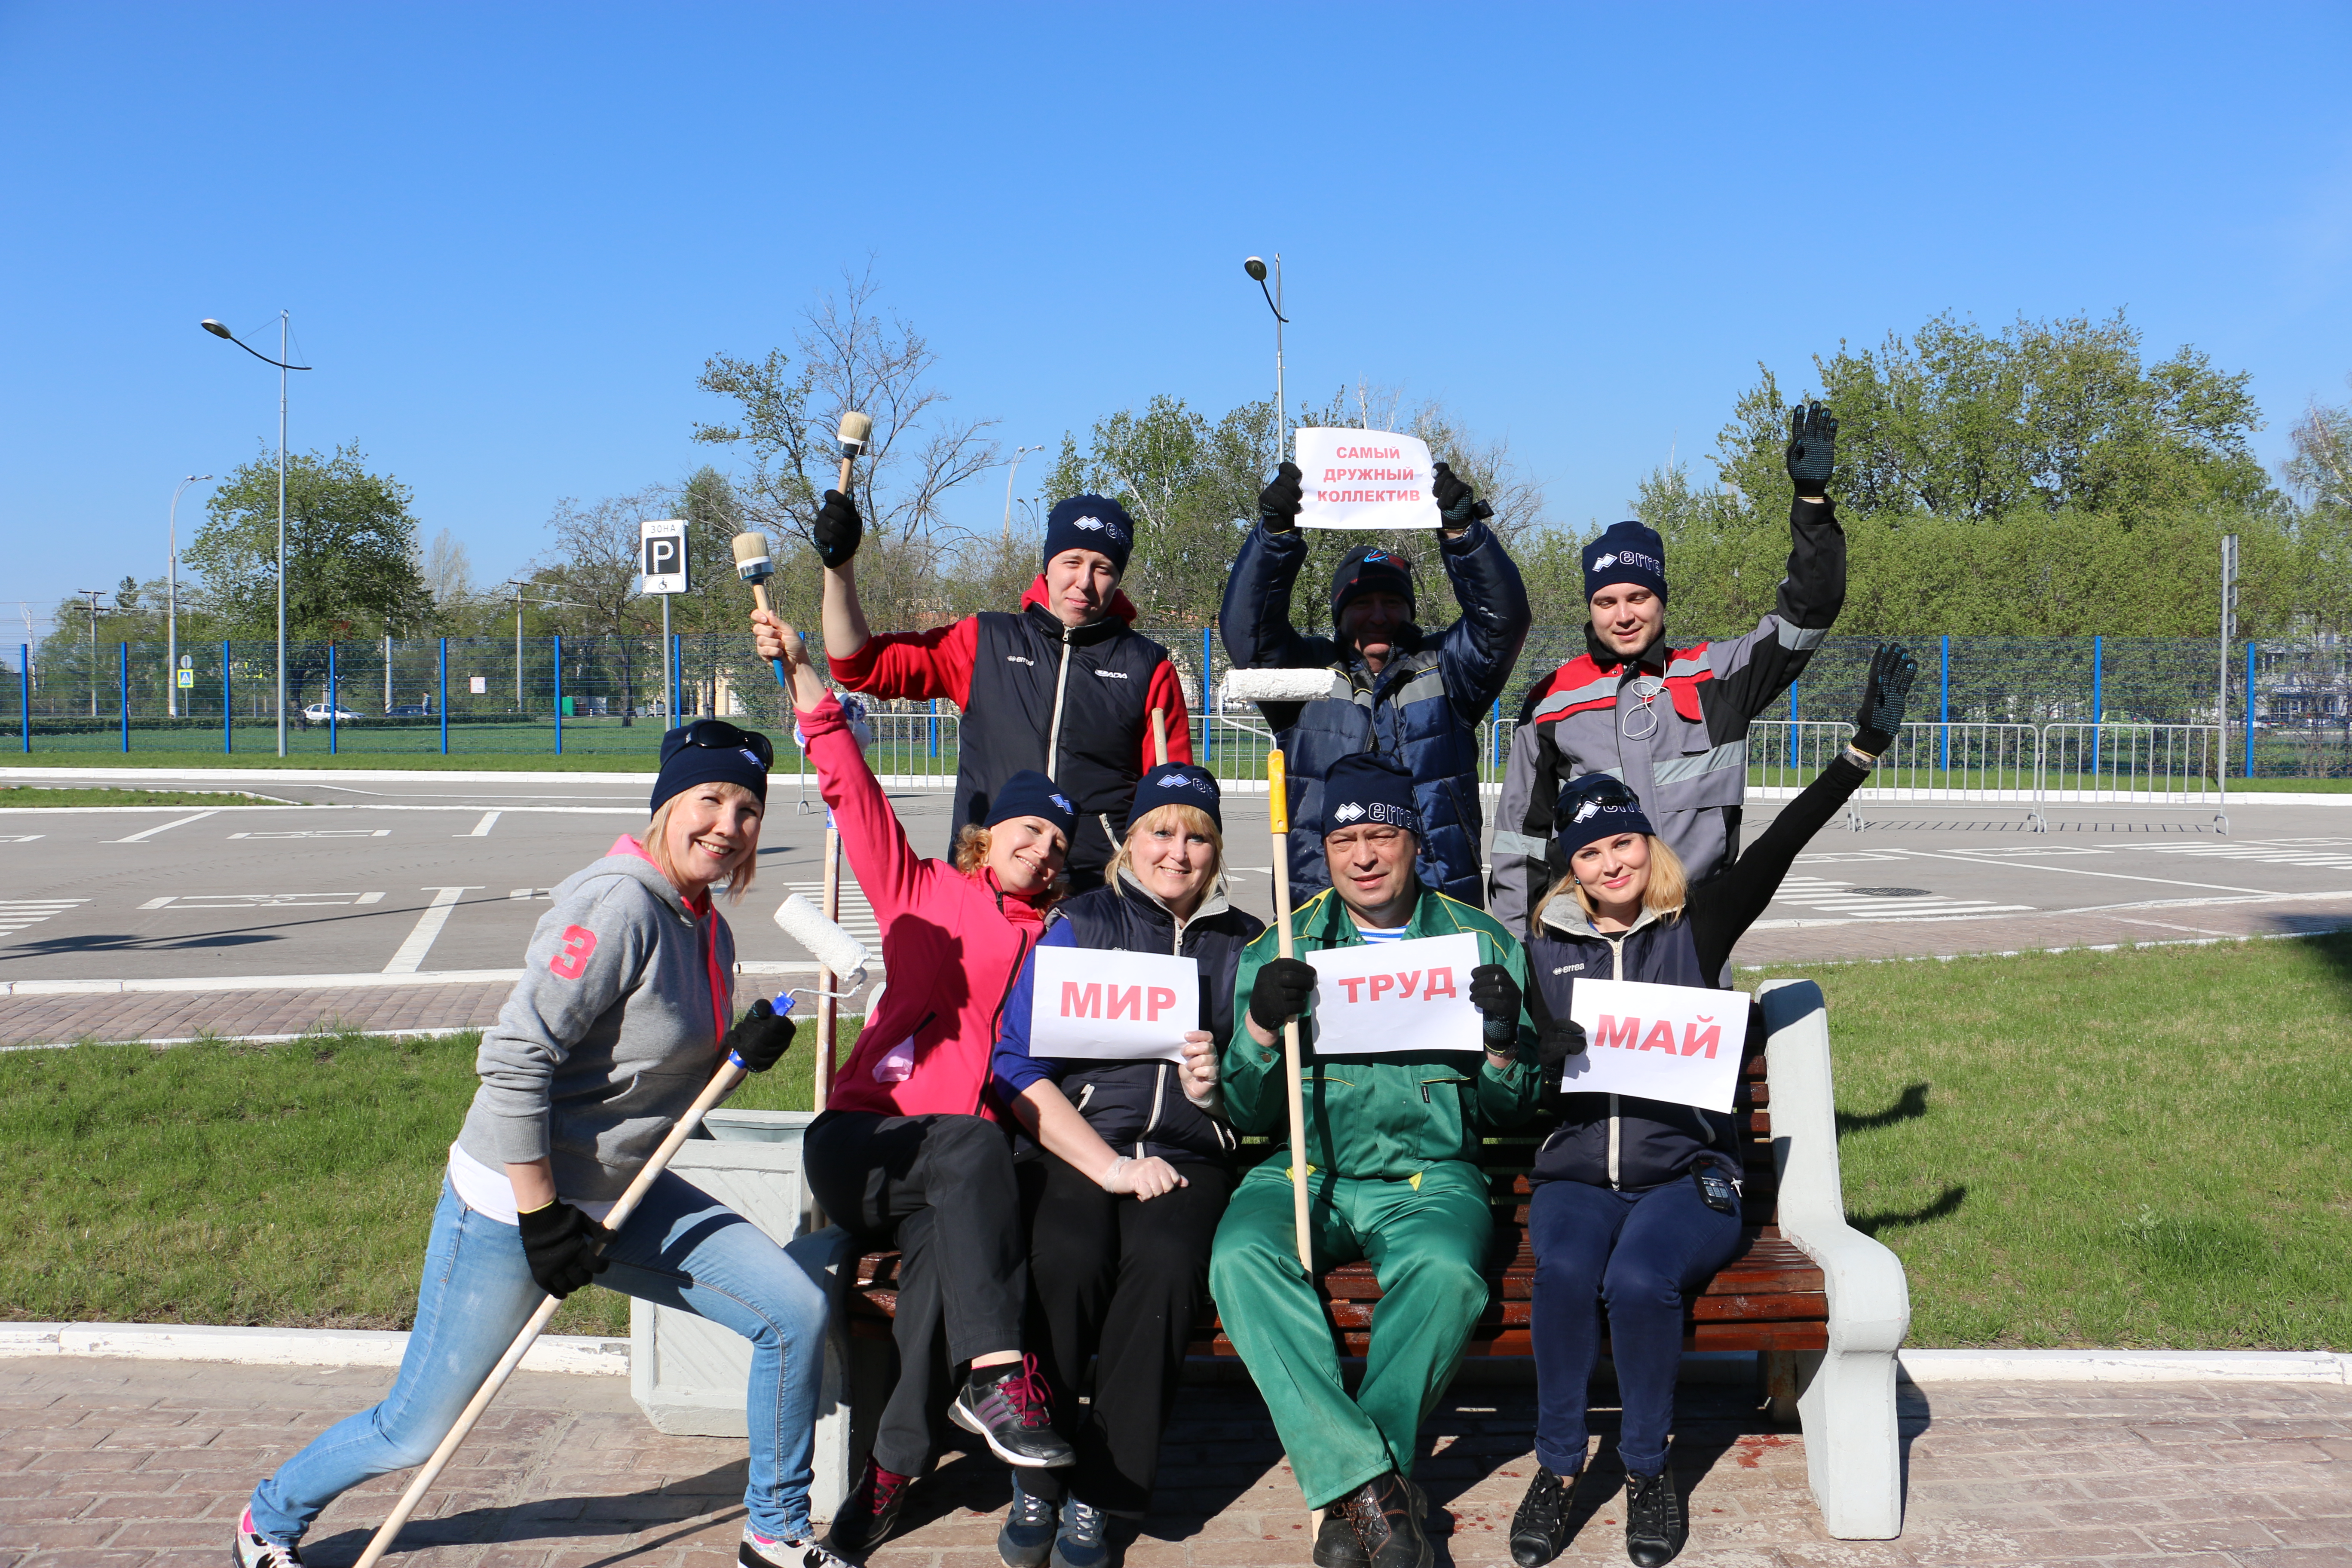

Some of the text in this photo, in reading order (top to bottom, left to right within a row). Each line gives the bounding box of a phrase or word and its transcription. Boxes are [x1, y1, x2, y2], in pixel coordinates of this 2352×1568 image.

[1336, 446, 1400, 459] САМЫЙ
[1323, 466, 1414, 483] ДРУЖНЫЙ
[1317, 490, 1420, 502] КОЛЛЕКТИВ
[650, 524, 676, 533] ЗОНА
[653, 541, 674, 573] P
[549, 924, 598, 980] 3
[1563, 962, 1585, 973] errea
[1338, 967, 1456, 1003] ТРУД
[1060, 981, 1176, 1022] МИР
[1594, 1014, 1721, 1059] МАЙ
